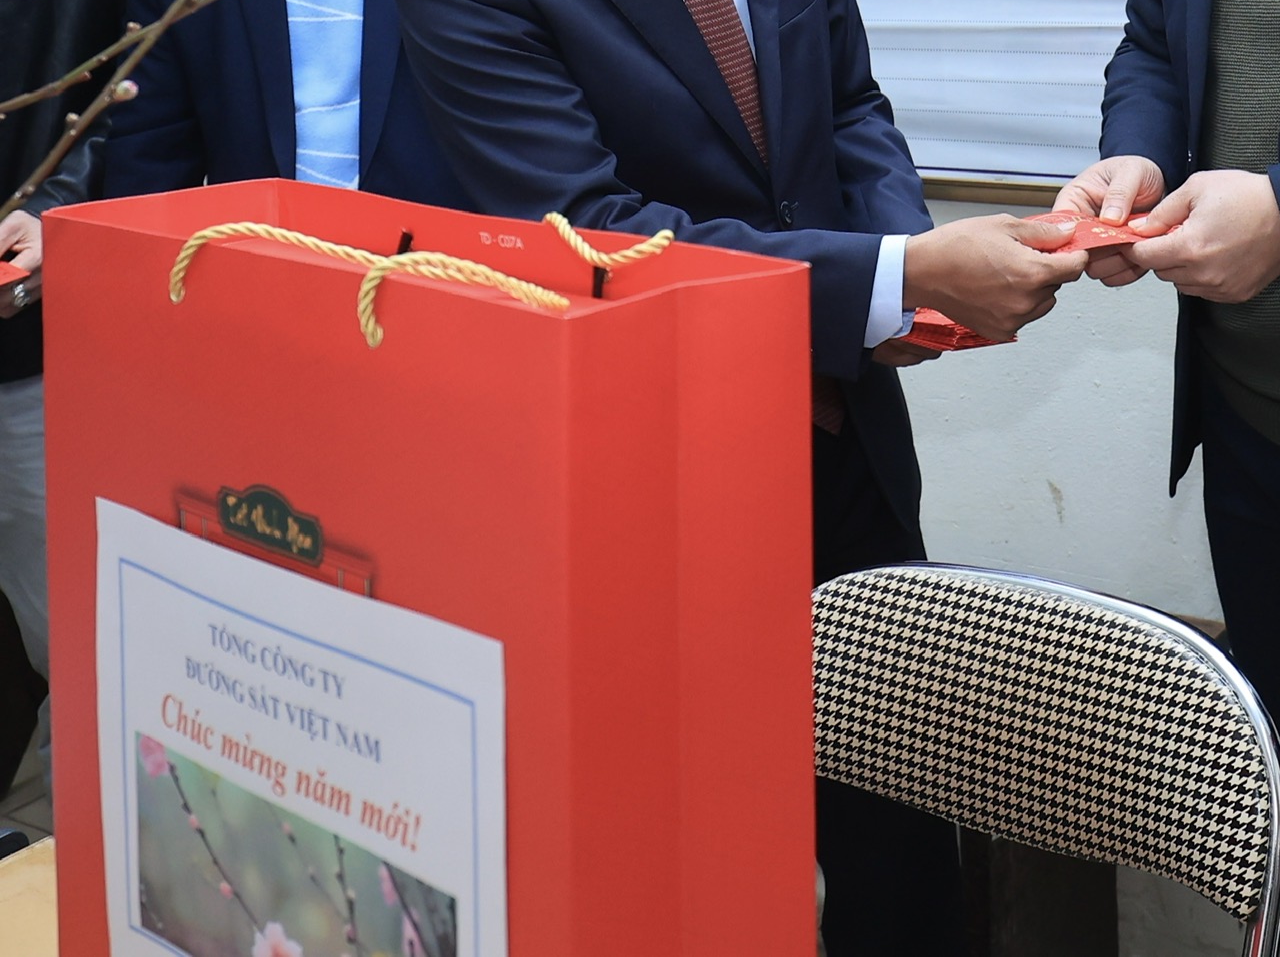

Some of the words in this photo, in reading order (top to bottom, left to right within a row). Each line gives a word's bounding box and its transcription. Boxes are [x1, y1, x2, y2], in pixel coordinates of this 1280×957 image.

[260, 645, 316, 688] CÔNG
[318, 668, 346, 700] TY
[285, 701, 331, 741] VIỆT
[335, 722, 382, 764] NAM
[160, 692, 214, 752] Chúc
[220, 732, 288, 798] mừng
[295, 769, 352, 817] năm
[359, 801, 424, 854] mới!
